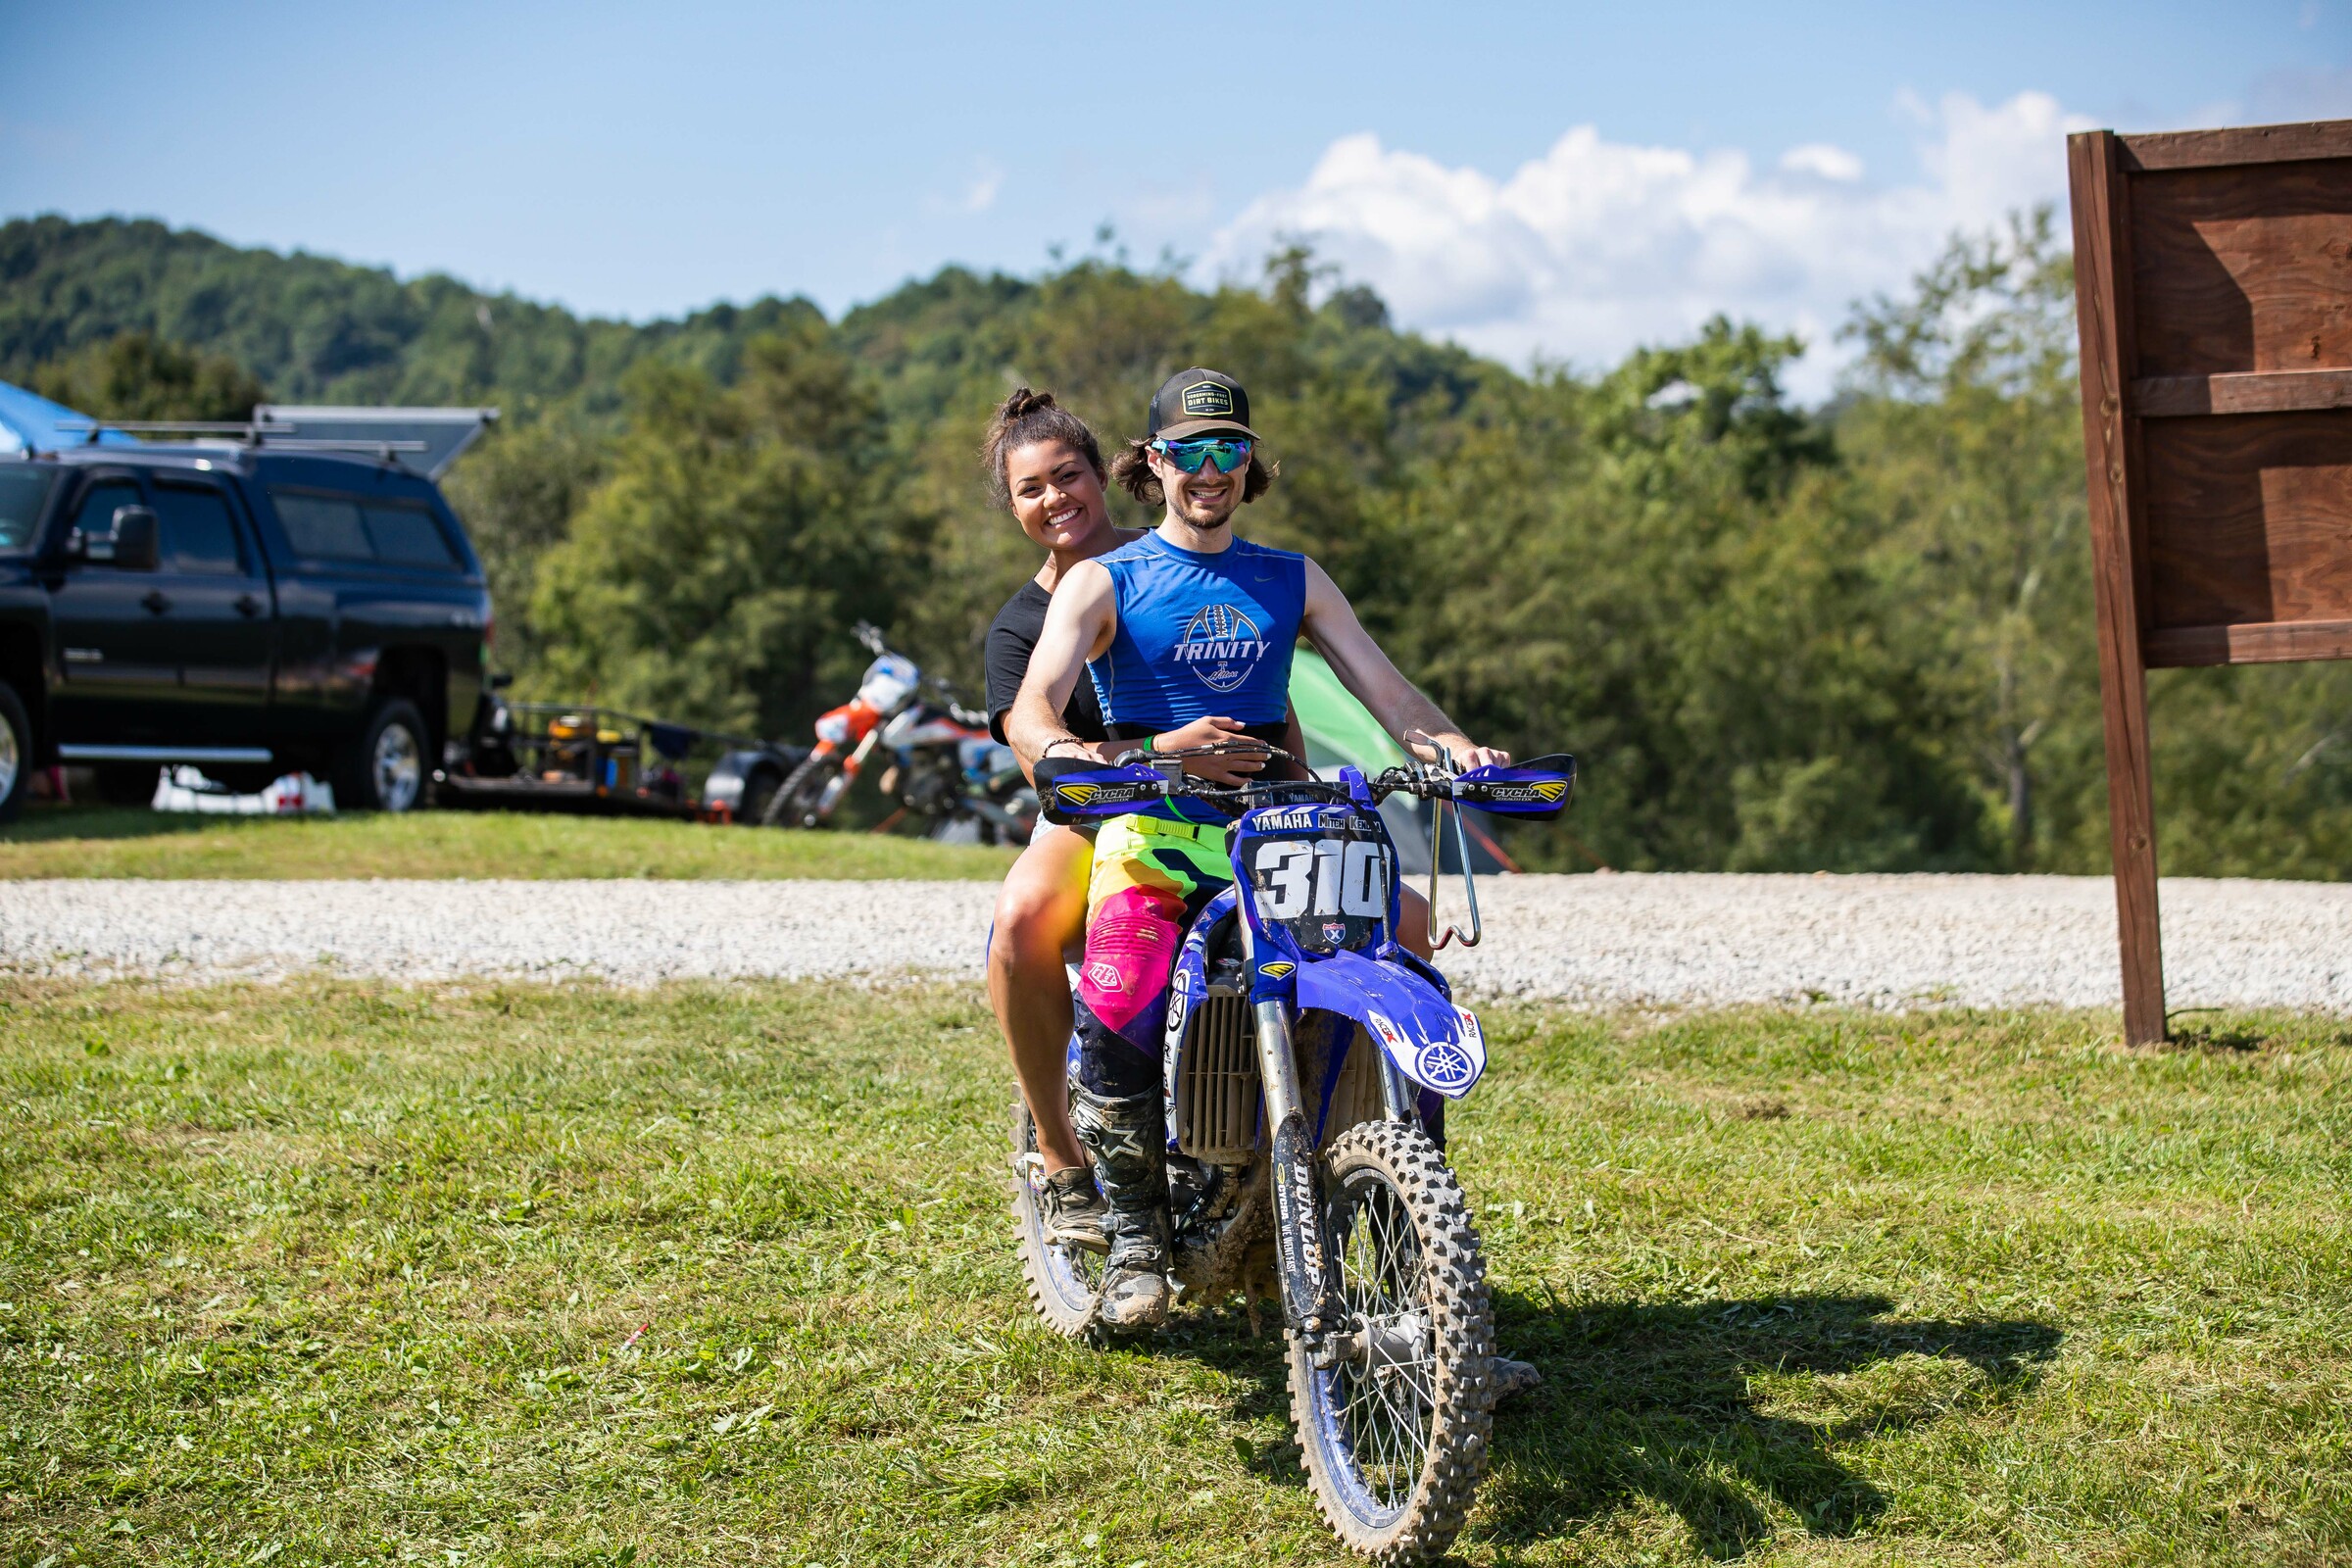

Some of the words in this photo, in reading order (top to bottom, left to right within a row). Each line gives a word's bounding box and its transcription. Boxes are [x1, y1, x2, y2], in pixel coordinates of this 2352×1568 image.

[1173, 640, 1272, 662] TRINITY
[1090, 788, 1135, 800] CYCRA
[1289, 792, 1319, 803] YAMAHA
[1492, 788, 1541, 798] CYCRA
[1251, 813, 1313, 832] YAMAHA
[1253, 839, 1392, 919] 310
[1278, 1184, 1290, 1220] CYCRA
[1282, 1224, 1293, 1237] WE
[1293, 1161, 1321, 1286] DUNLOP
[1283, 1236, 1295, 1257] WENT
[1285, 1255, 1297, 1273] FAST
